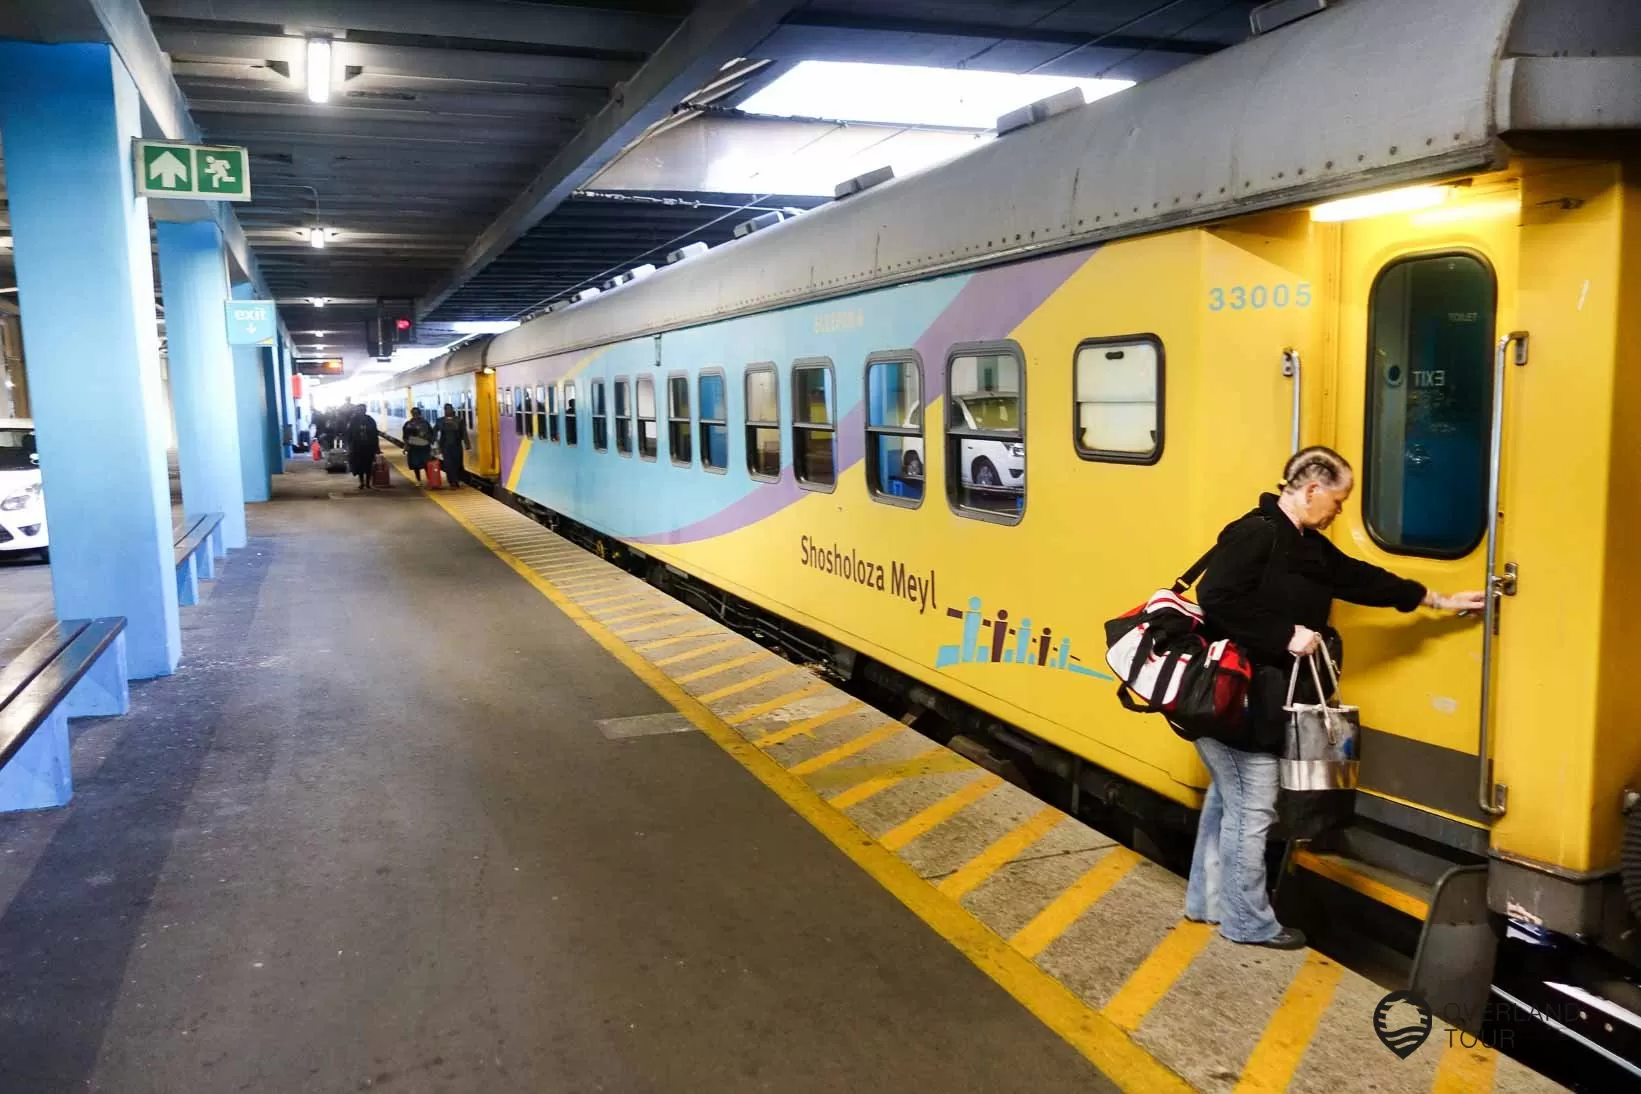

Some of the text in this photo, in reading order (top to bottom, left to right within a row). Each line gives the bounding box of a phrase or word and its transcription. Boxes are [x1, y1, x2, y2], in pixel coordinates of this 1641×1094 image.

[1208, 283, 1312, 312] 33005
[235, 307, 266, 321] exit
[801, 535, 937, 615] Shosholoza Meyl
